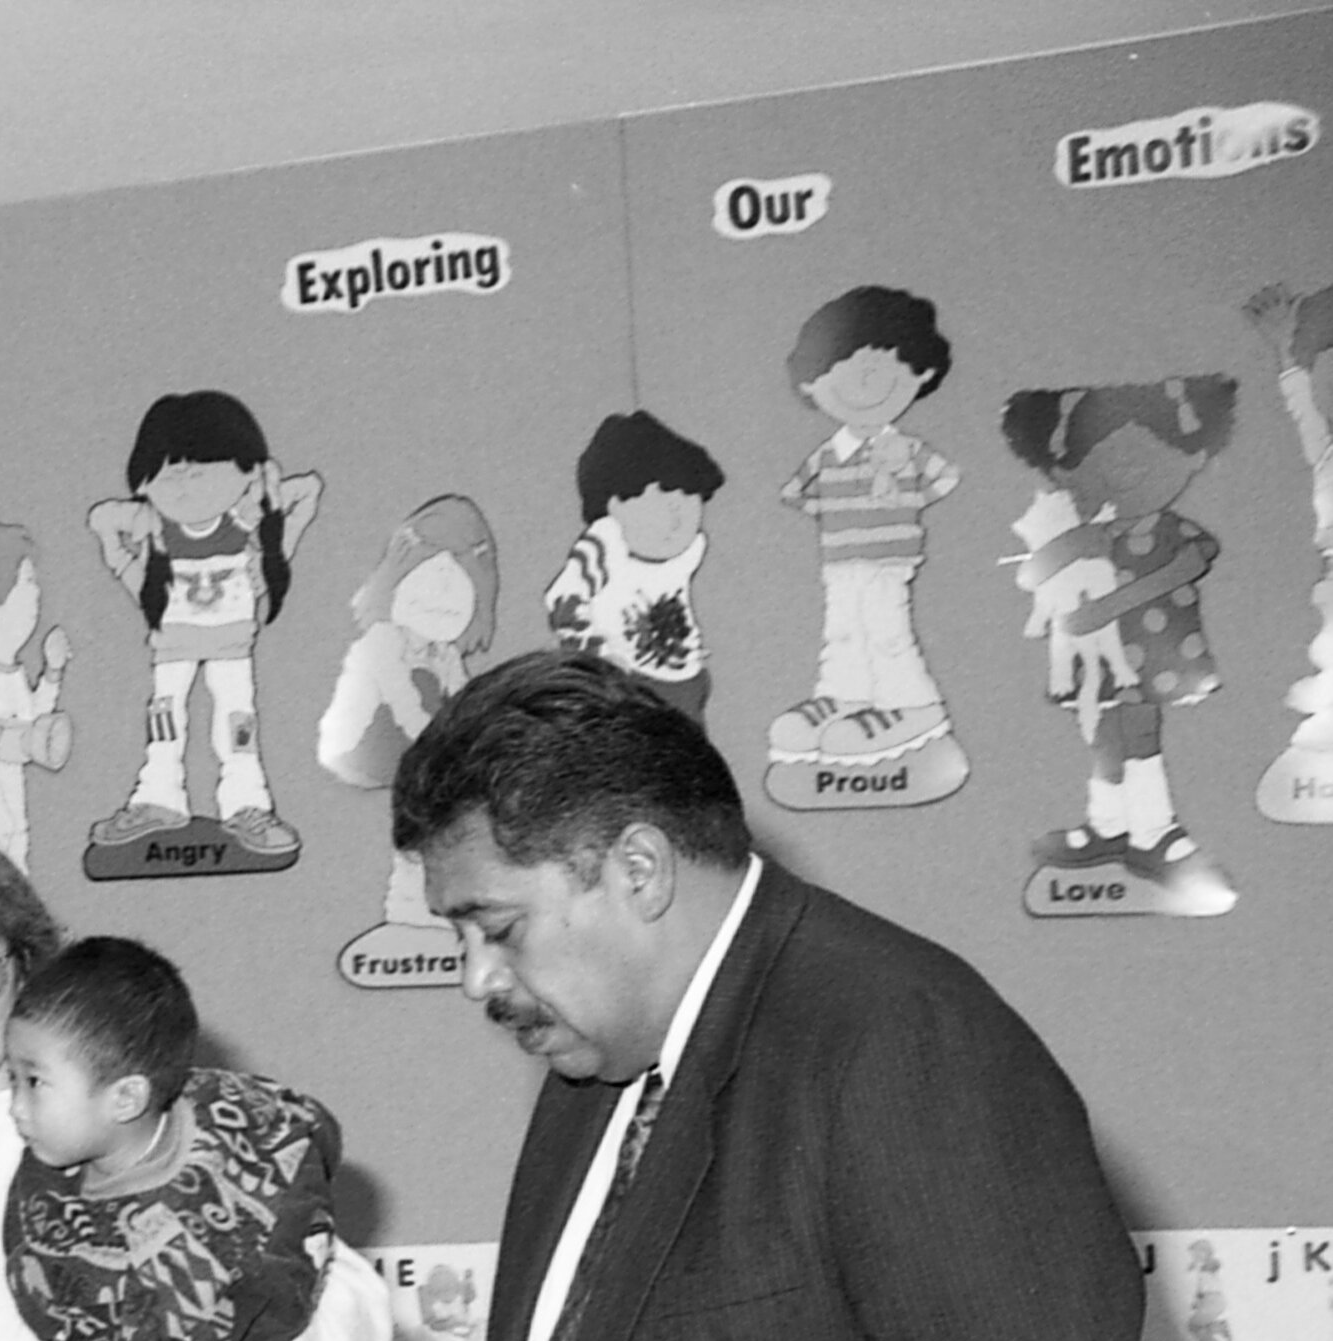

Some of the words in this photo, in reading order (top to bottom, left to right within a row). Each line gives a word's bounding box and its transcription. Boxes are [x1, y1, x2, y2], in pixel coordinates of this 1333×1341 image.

[297, 240, 500, 308] Exploring
[728, 185, 814, 230] Our
[1068, 115, 1311, 184] Emotis
[816, 766, 909, 794] Proud
[145, 842, 228, 868] Angry
[1050, 879, 1127, 902] Love
[351, 952, 467, 976] Frustra
[397, 1258, 416, 1287] E
[1266, 1241, 1281, 1284] j
[1304, 1241, 1332, 1272] K
